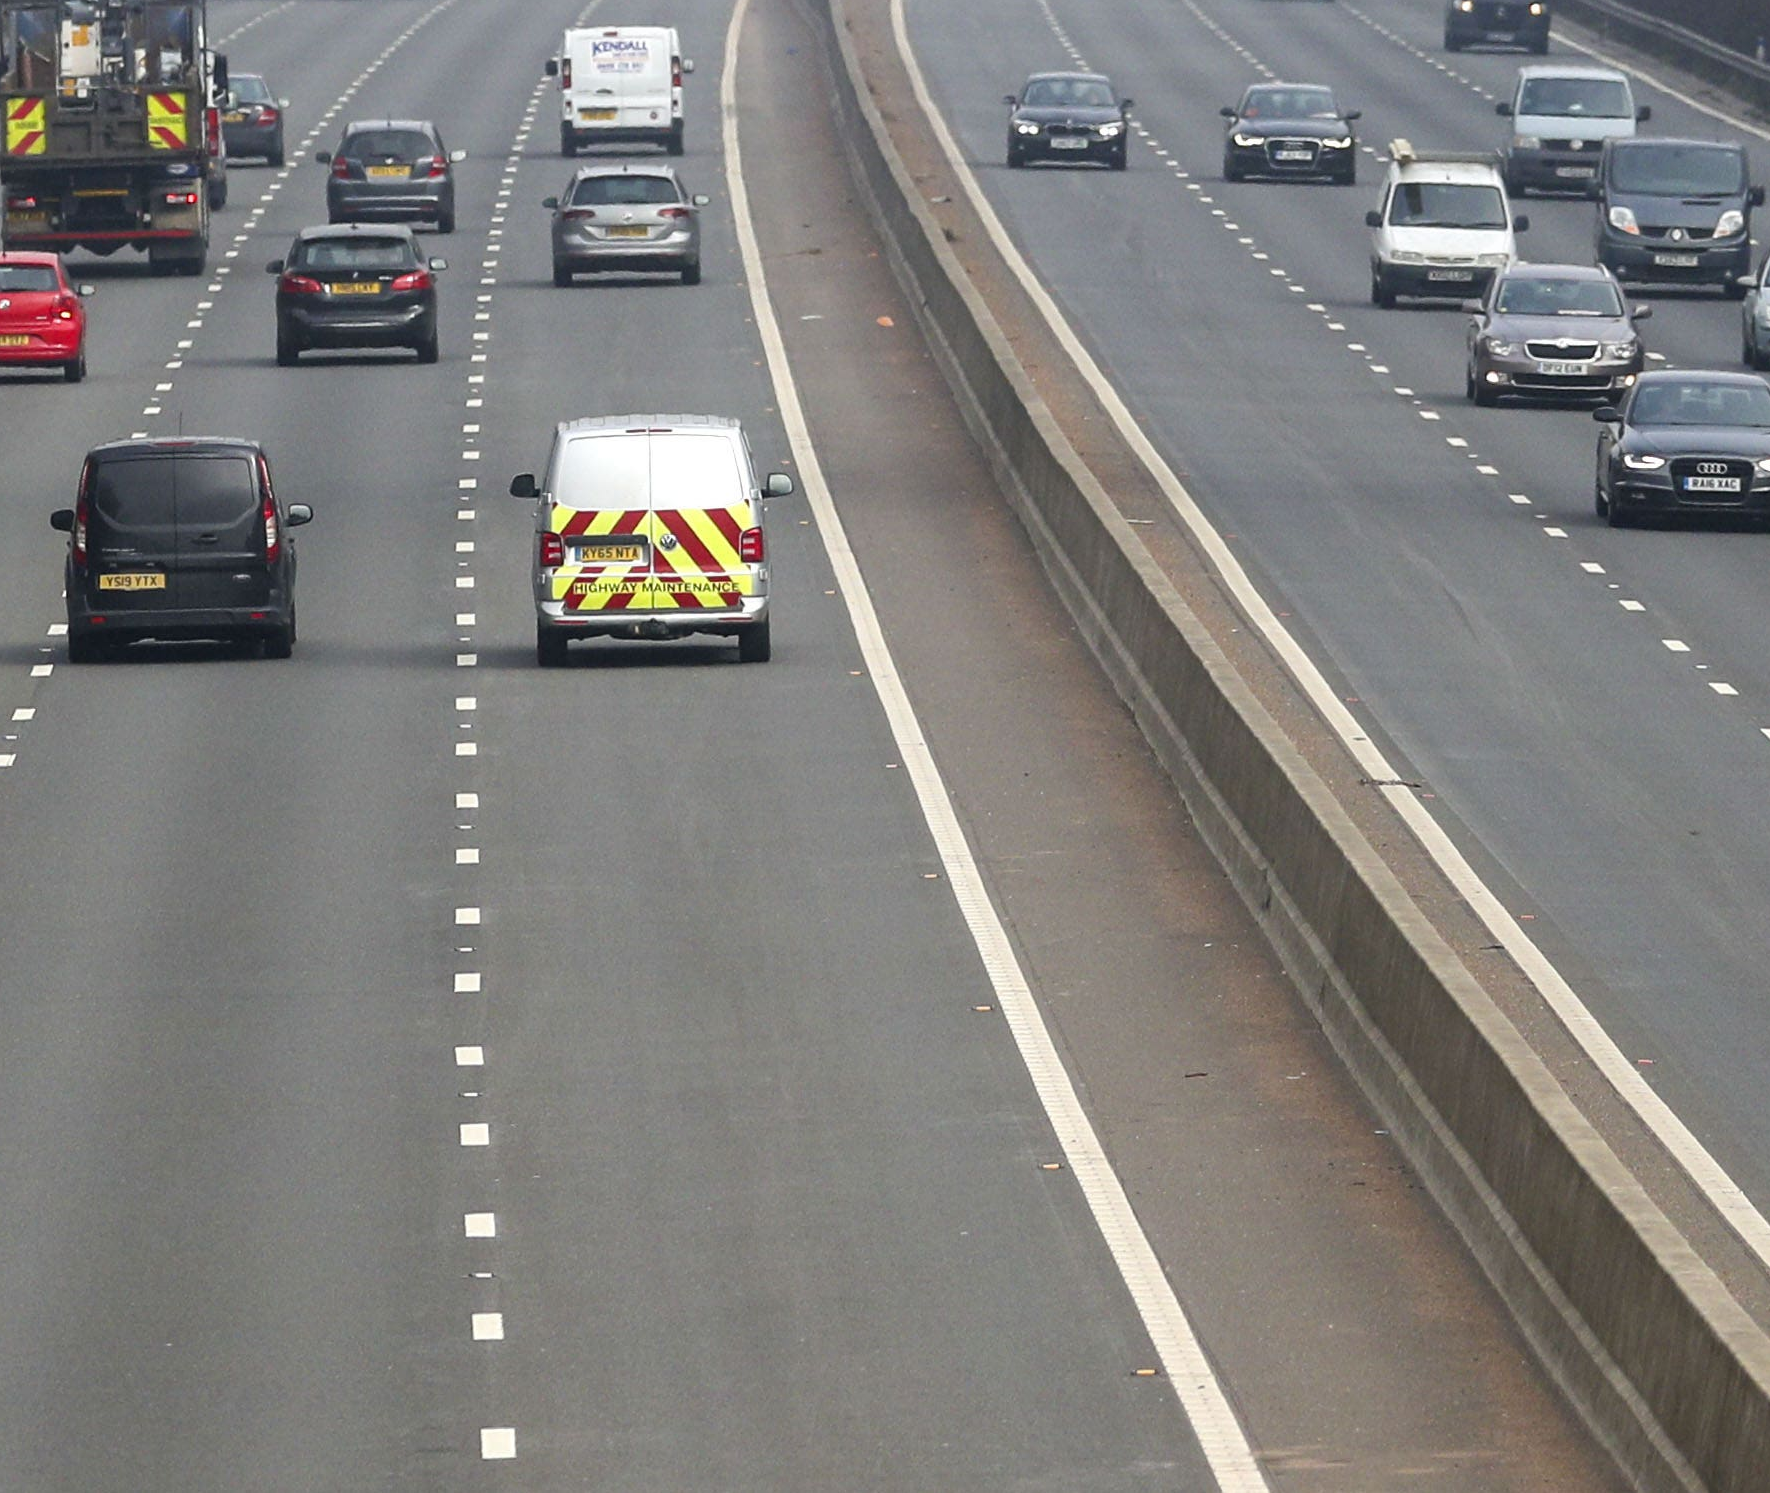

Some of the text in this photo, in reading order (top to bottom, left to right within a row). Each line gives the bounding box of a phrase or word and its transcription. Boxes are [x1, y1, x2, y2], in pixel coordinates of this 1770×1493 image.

[592, 40, 647, 56] KENDALL
[582, 546, 639, 559] KY65 NTA
[135, 575, 157, 586] YTX
[574, 582, 740, 594] HIGHWAY MAINTENANCE
